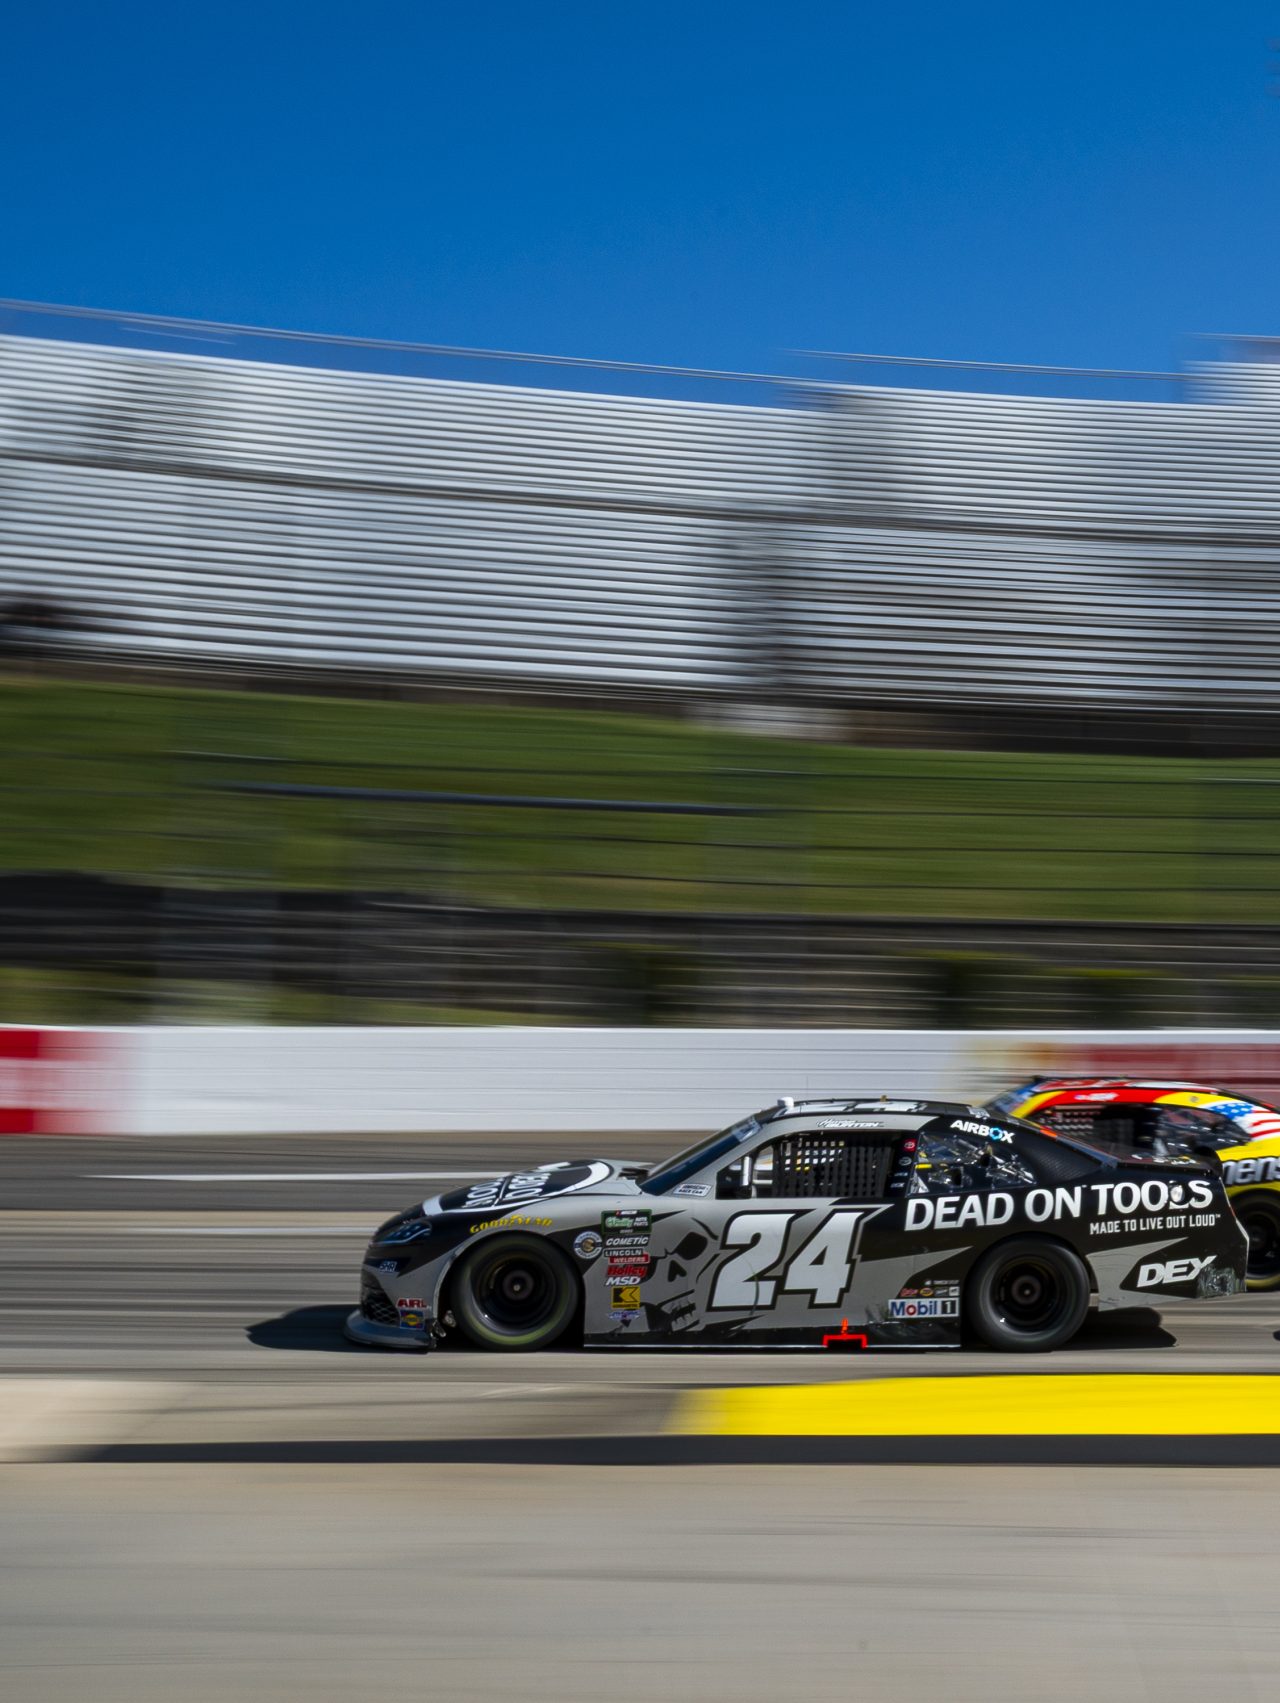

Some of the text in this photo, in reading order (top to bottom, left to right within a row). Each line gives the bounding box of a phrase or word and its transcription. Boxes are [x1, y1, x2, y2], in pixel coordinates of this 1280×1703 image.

[950, 1119, 1015, 1144] AIRBOX
[904, 1194, 1014, 1231] DEAD
[1024, 1186, 1081, 1222] ON
[469, 1214, 554, 1235] GOODYEAR
[1089, 1220, 1121, 1235] MADE
[1123, 1219, 1138, 1232] TO
[1139, 1217, 1164, 1231] LIVE
[1166, 1215, 1187, 1229] OUT
[606, 1236, 649, 1246] COMETIC
[605, 1249, 641, 1257] LINCOLN
[708, 1209, 868, 1309] 24
[605, 1276, 641, 1286] MSD
[607, 1265, 647, 1277] Holley
[1137, 1255, 1217, 1288] DEX
[891, 1301, 937, 1316] Mobil
